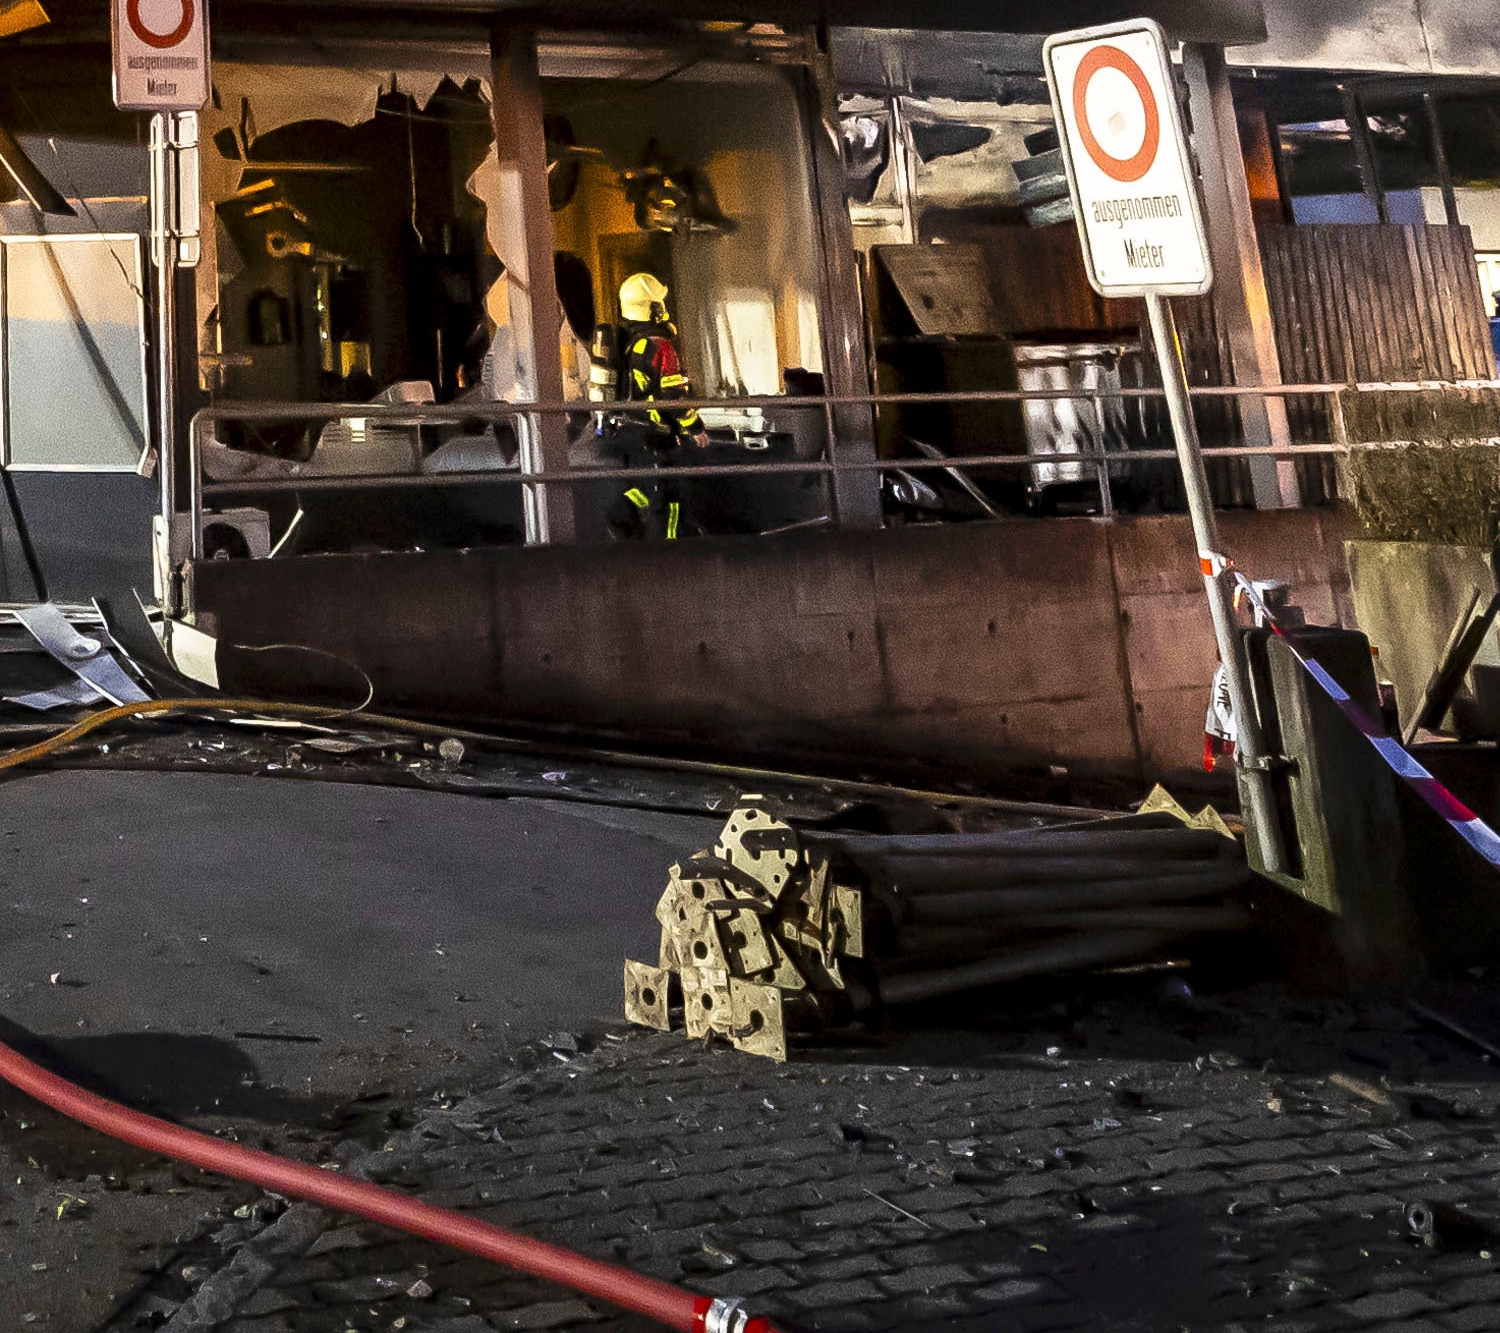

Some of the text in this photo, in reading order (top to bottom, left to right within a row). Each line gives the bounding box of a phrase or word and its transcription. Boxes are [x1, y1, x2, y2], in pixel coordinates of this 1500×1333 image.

[127, 55, 200, 71] ausgenommen
[147, 77, 178, 96] Mieter
[1092, 194, 1182, 229] ausgenommen
[1123, 238, 1165, 268] Mieter
